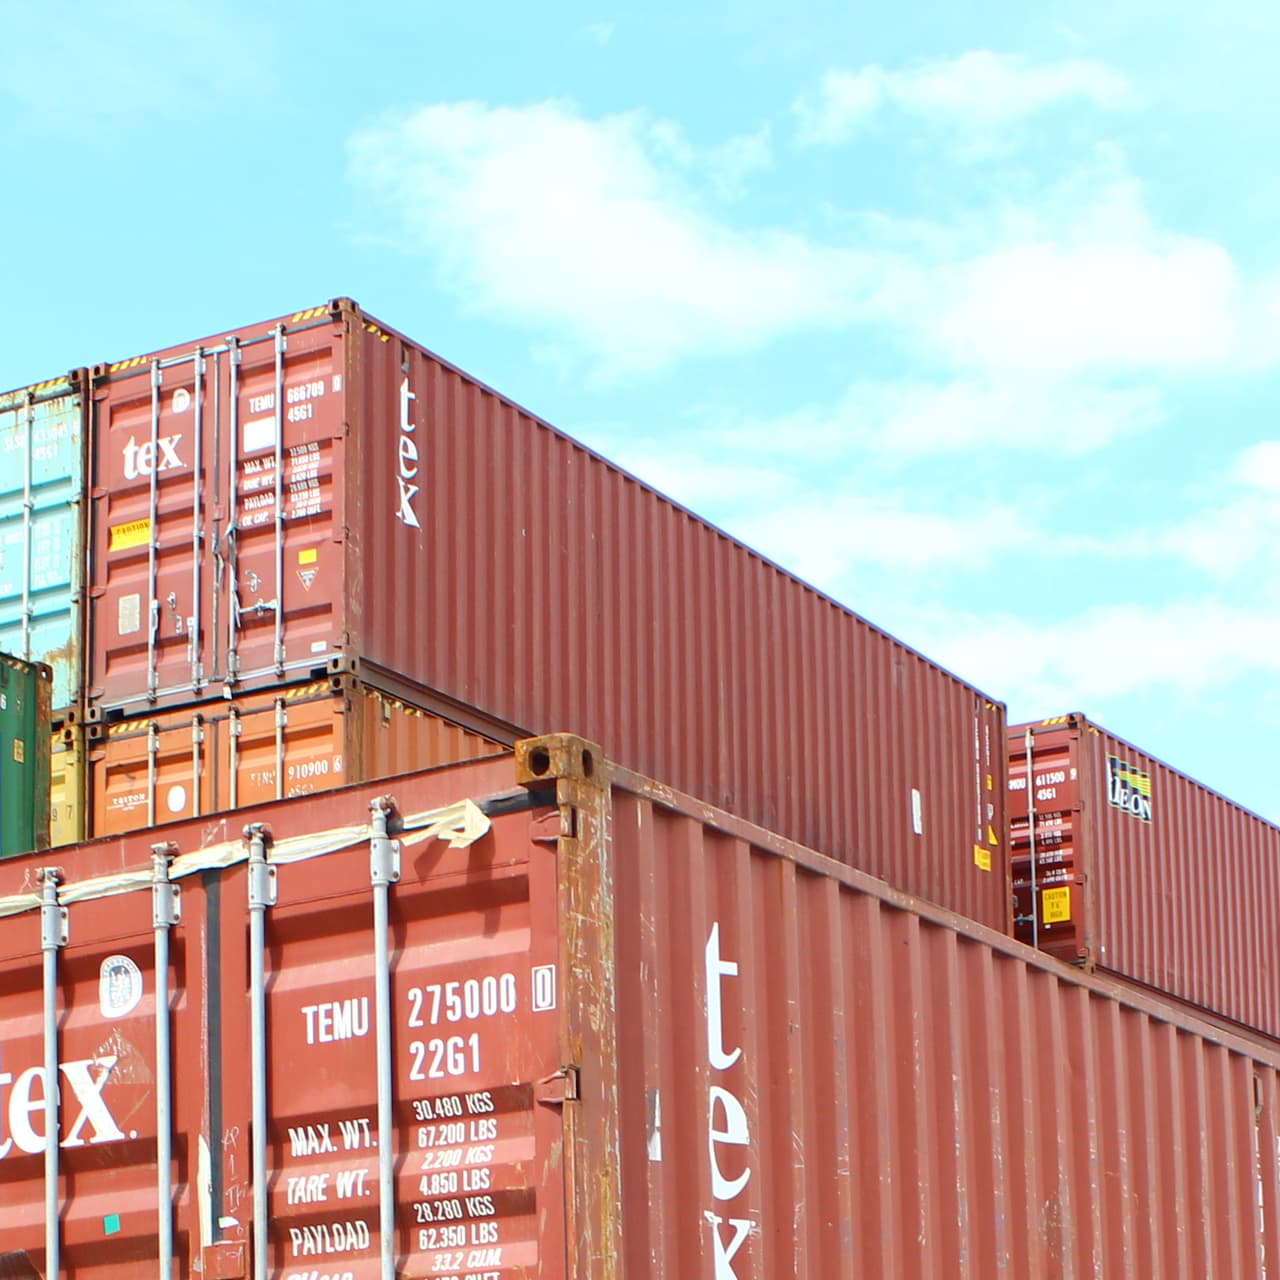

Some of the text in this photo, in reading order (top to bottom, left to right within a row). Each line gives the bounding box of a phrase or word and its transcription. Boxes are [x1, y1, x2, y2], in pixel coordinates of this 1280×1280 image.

[249, 394, 274, 414] TEMU
[396, 377, 420, 528] tex
[244, 492, 274, 511] PAYLOAD
[288, 760, 328, 780] 910900
[301, 997, 369, 1044] TEMU
[408, 973, 516, 1028] 275000
[409, 1033, 480, 1081] 22G1
[413, 1092, 495, 1121] 30.480 KGS
[288, 1119, 377, 1157] MAX. WT.
[418, 1119, 497, 1148] 67.200 LBS
[421, 1145, 495, 1170] 2.200 KGS
[287, 1169, 370, 1205] TARE WT.
[419, 1169, 490, 1196] 4.850 LBS
[414, 1196, 495, 1223] 28.280 KGS
[289, 1220, 370, 1257] PAYLOAD
[419, 1222, 498, 1250] 62.350 LBS
[431, 1252, 461, 1271] 33.2
